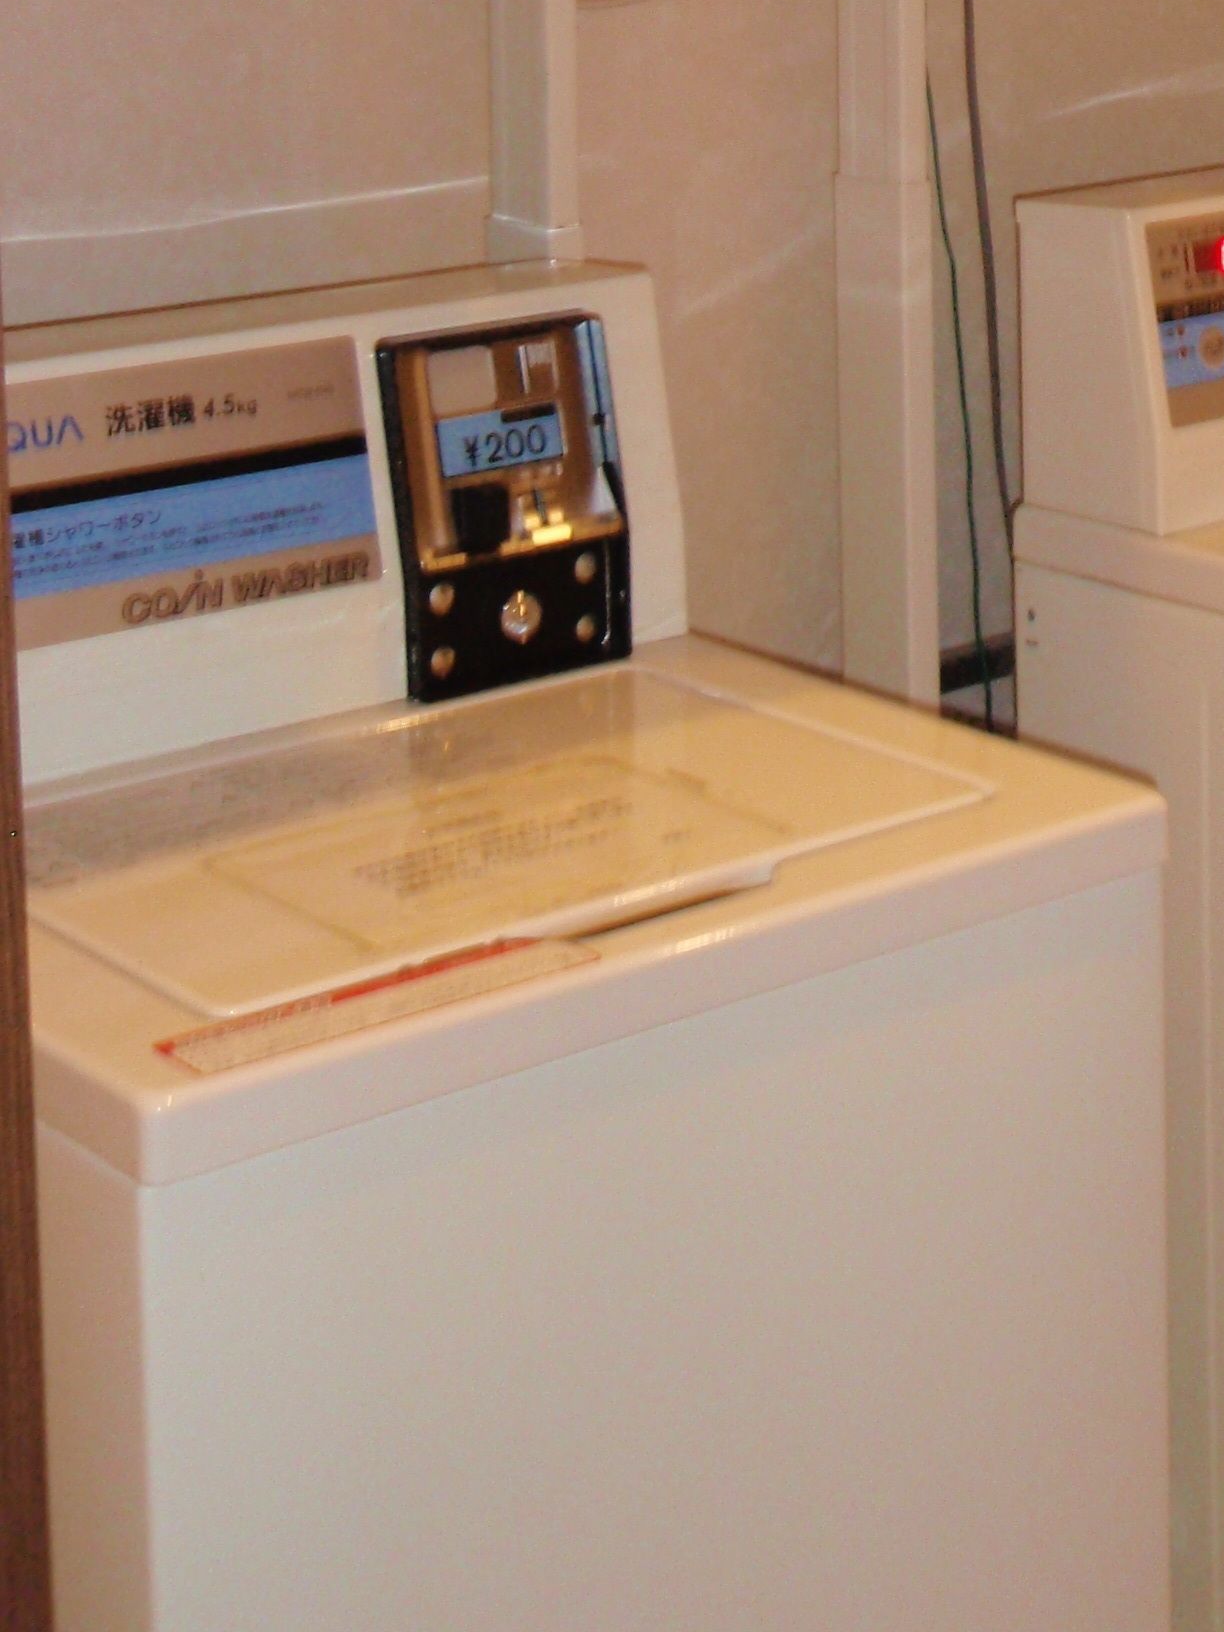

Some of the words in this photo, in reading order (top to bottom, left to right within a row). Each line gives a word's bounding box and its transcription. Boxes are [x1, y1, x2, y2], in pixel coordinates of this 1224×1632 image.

[105, 393, 196, 438] 洗濯機
[463, 423, 548, 467] ¥200
